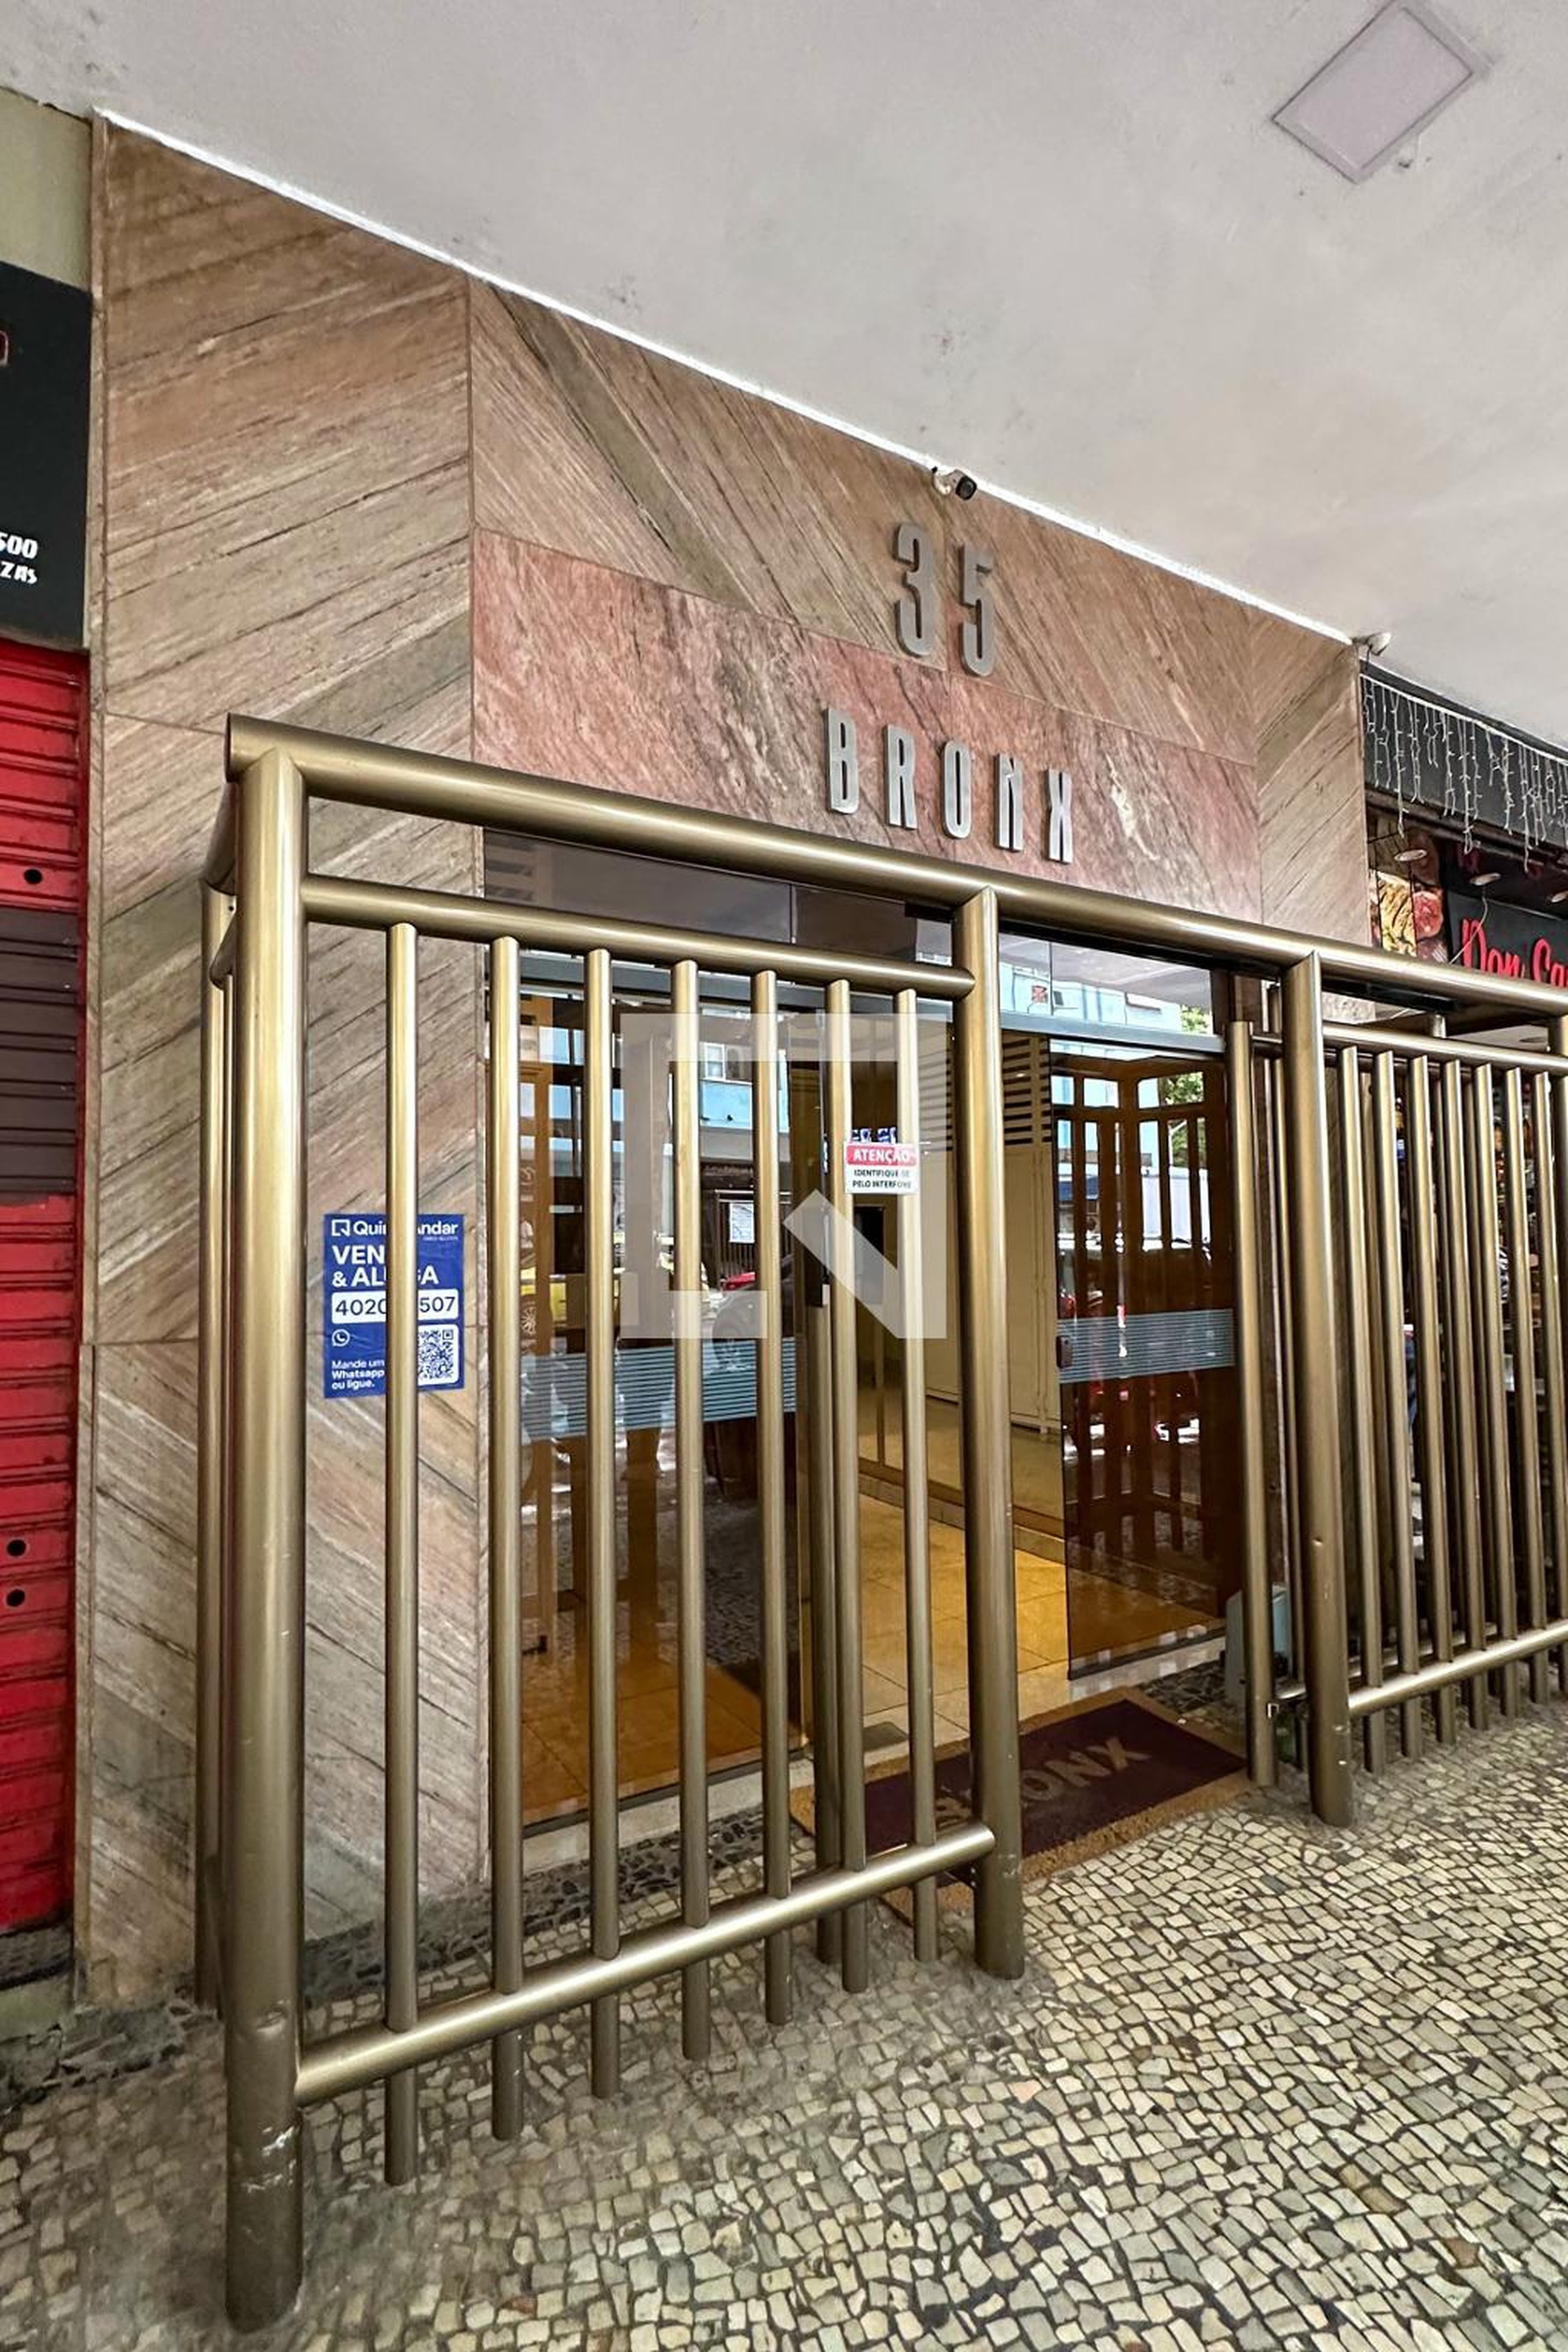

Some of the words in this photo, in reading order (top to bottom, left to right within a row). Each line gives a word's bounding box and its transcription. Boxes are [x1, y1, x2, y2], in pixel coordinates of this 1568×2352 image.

[893, 523, 995, 677] 35
[825, 708, 1073, 864] BRONX
[853, 1148, 909, 1164] ATENÇÃO
[332, 1271, 347, 1287] &
[351, 1265, 439, 1287] ALA
[332, 1370, 385, 1379] Whatsapp
